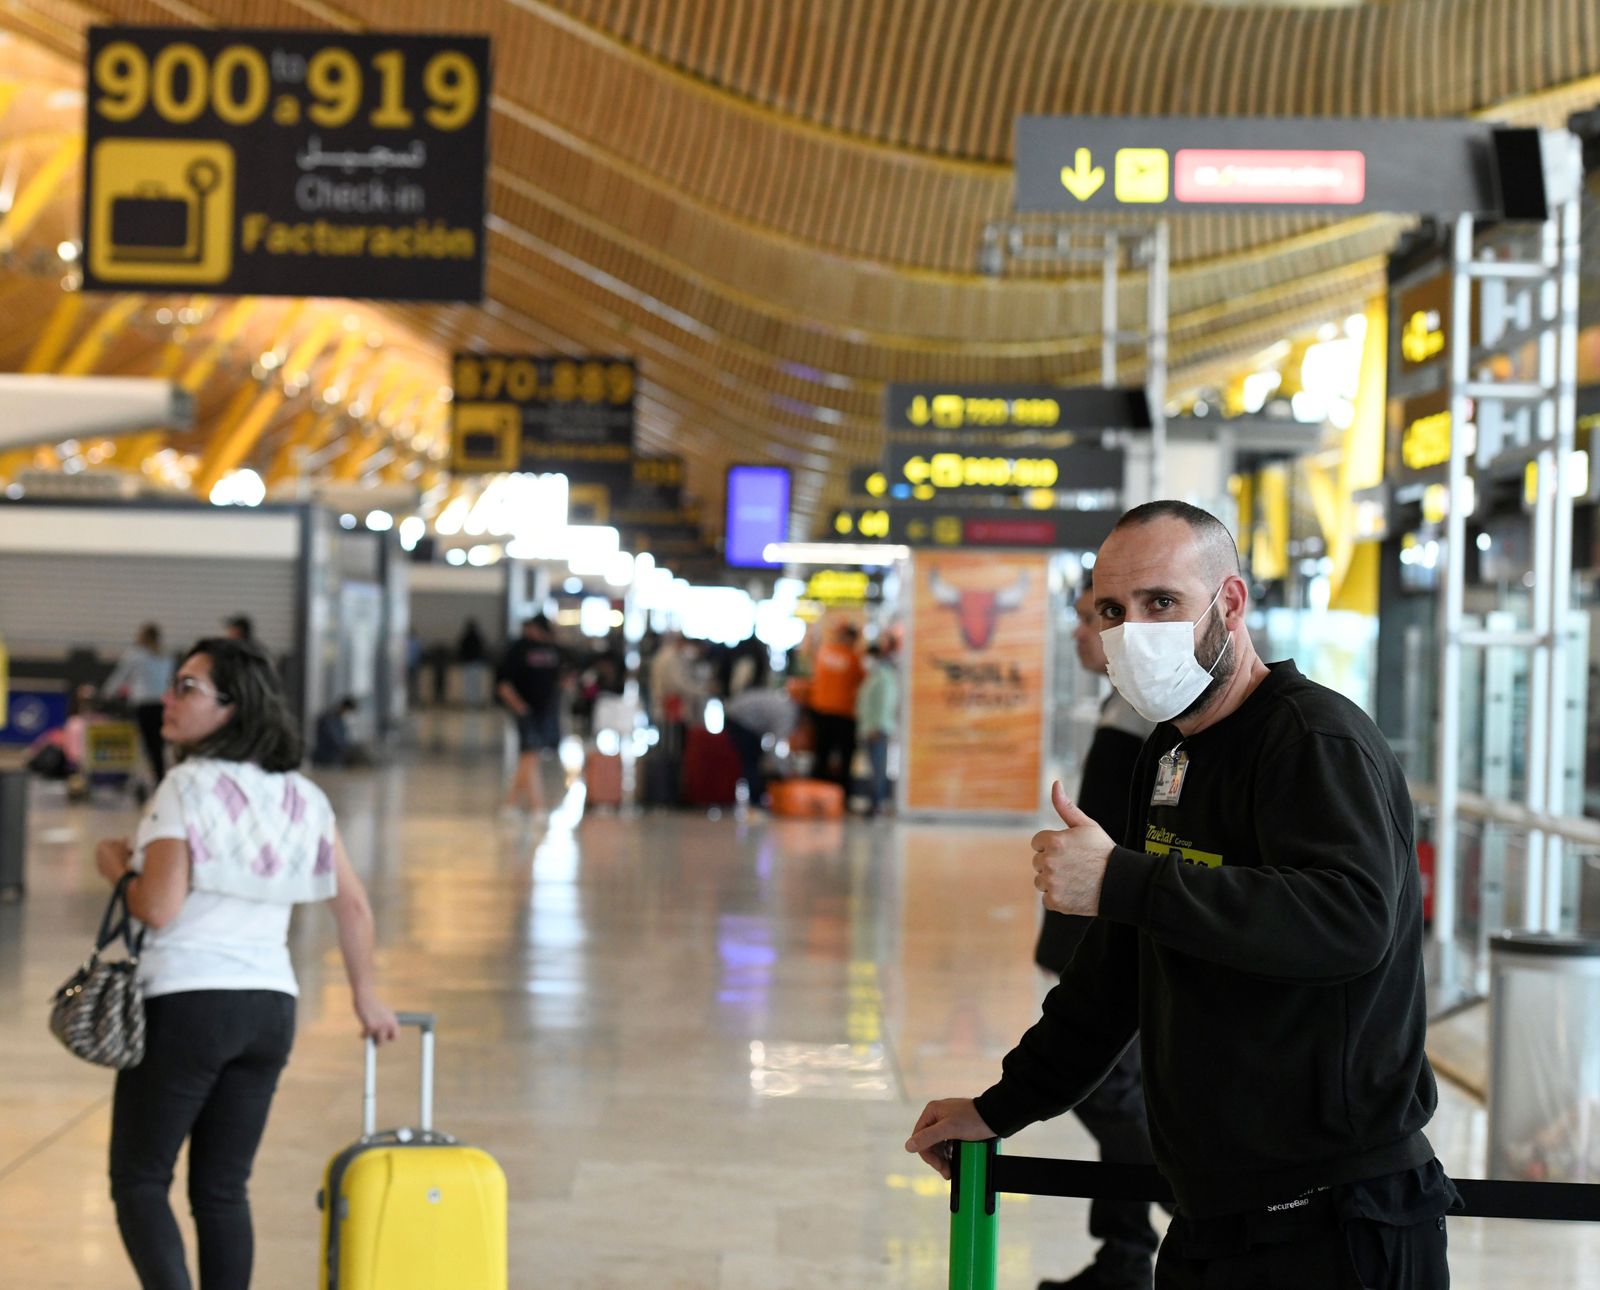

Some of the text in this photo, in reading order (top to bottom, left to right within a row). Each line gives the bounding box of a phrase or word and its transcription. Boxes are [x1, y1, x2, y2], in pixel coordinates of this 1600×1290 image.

[94, 40, 270, 125] 900
[306, 46, 480, 131] 919
[241, 213, 475, 258] Facturación
